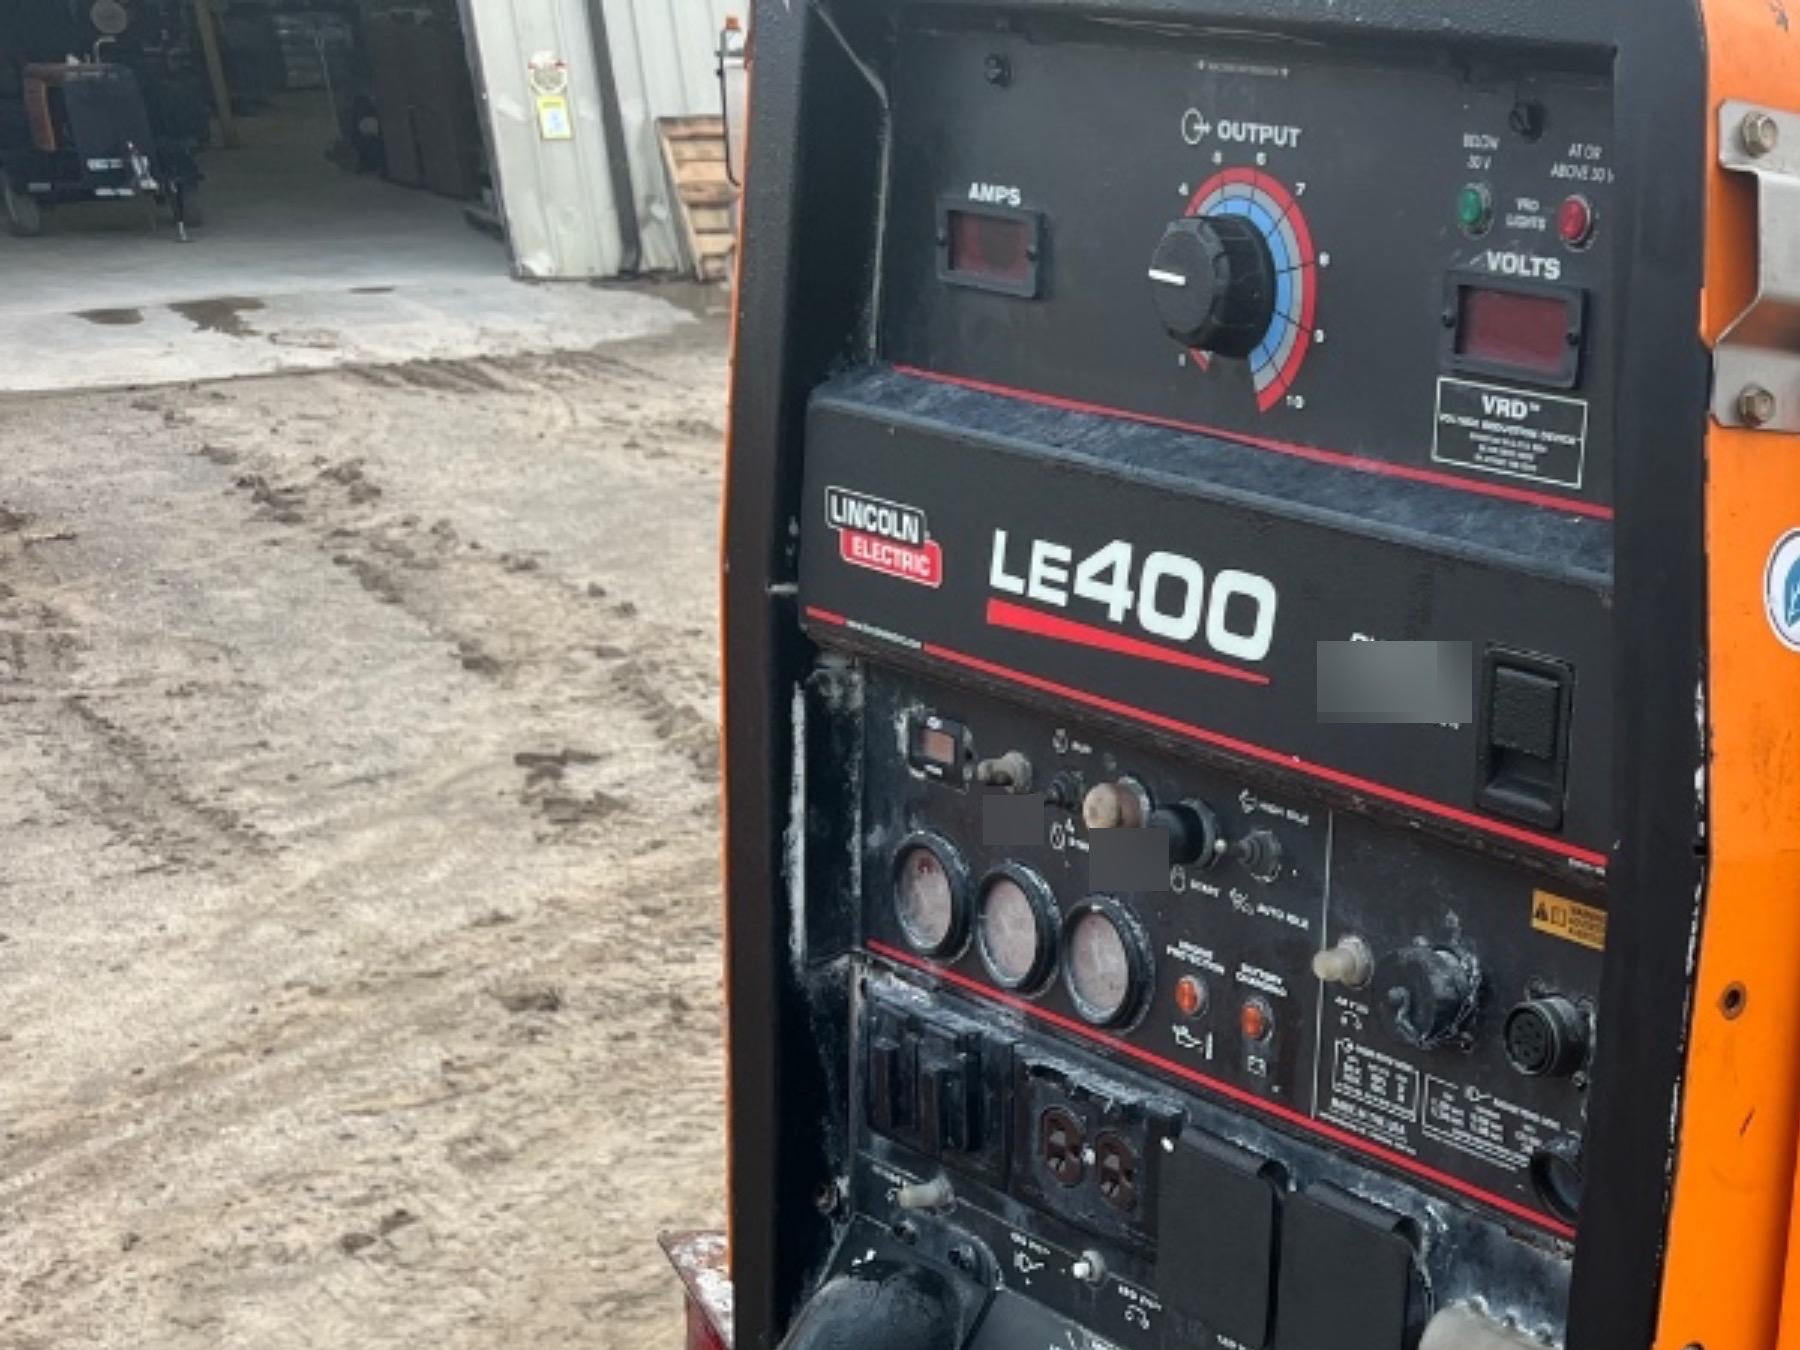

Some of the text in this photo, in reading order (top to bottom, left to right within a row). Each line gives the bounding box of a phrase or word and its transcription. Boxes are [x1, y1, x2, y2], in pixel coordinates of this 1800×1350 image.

[1217, 119, 1302, 148] OUTPUT
[967, 182, 1021, 208] AMPS
[1487, 249, 1562, 280] VOLTS
[830, 493, 920, 545] LINCOLN
[851, 535, 932, 577] ELECTRIC
[988, 528, 1278, 662] LE400
